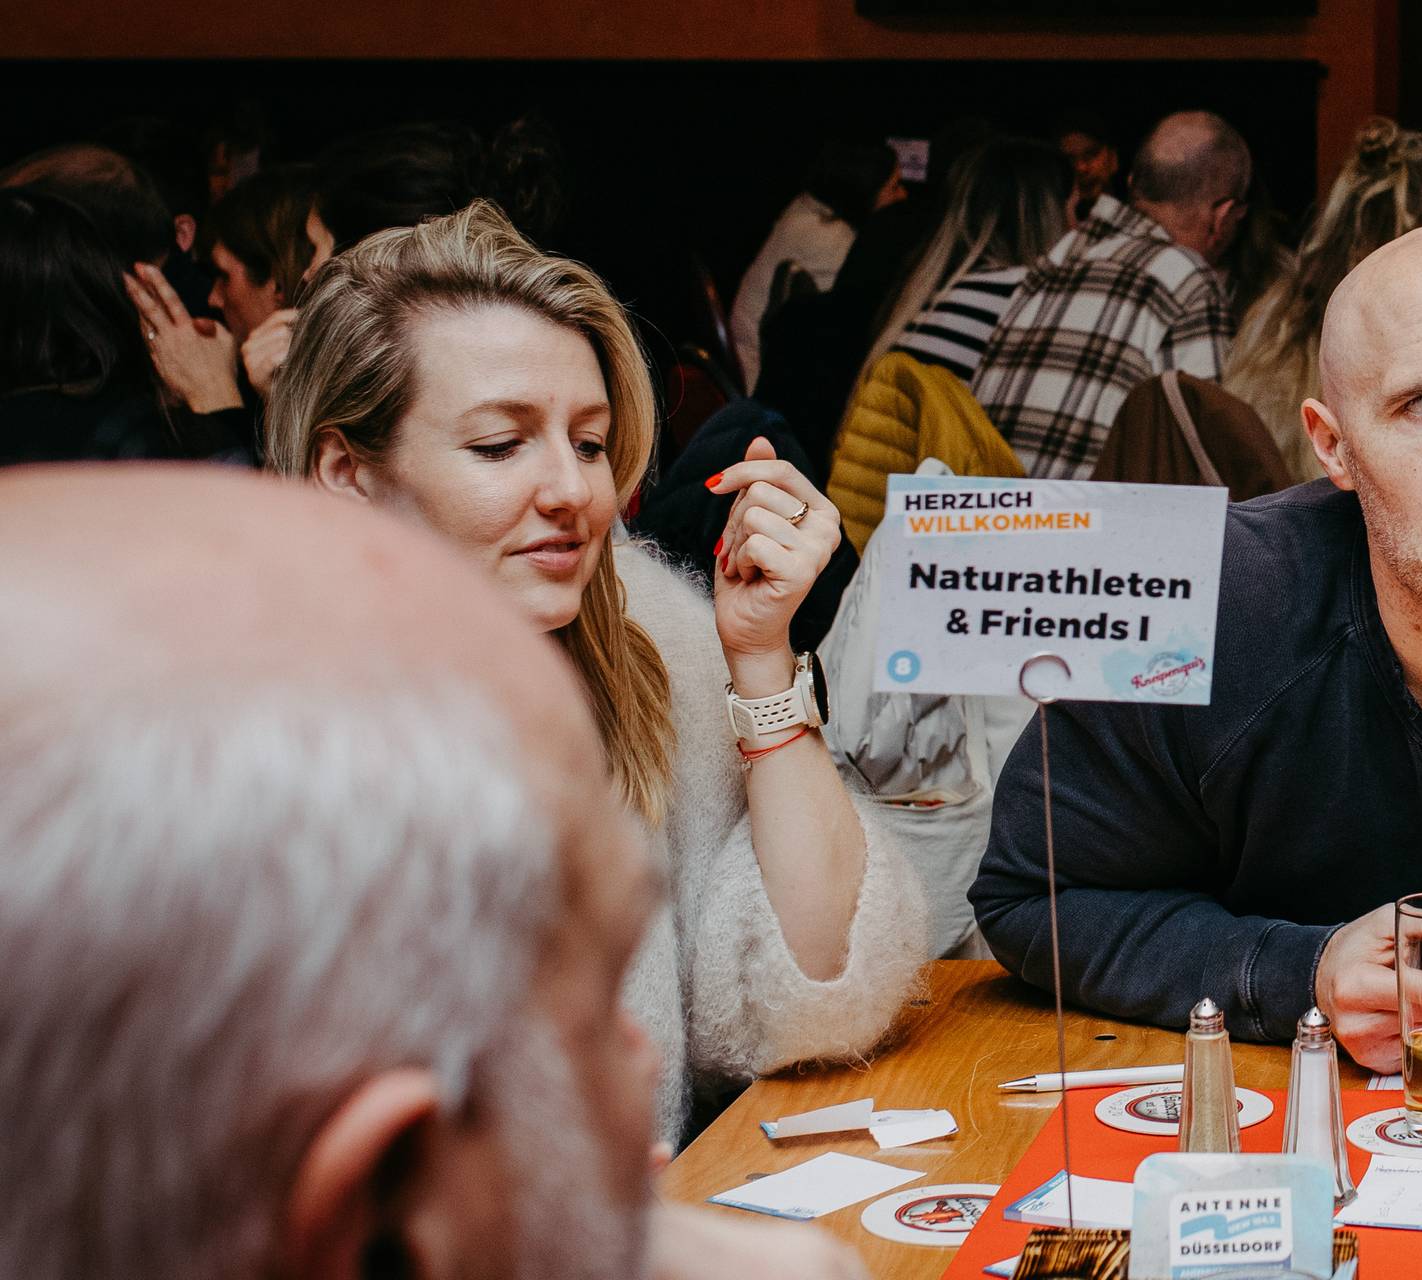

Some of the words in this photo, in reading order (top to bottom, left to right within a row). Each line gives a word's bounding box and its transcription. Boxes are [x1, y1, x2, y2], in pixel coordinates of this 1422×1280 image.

[905, 491, 1033, 511] HERZLICH
[909, 512, 1091, 533] WILLKOMMEN
[909, 562, 1192, 600] Naturathleten
[946, 608, 970, 635] &
[980, 607, 1130, 641] Friends
[895, 657, 912, 676] 8
[1180, 1197, 1281, 1213] ANTENNE
[1180, 1241, 1282, 1256] DÜSSELDORF
